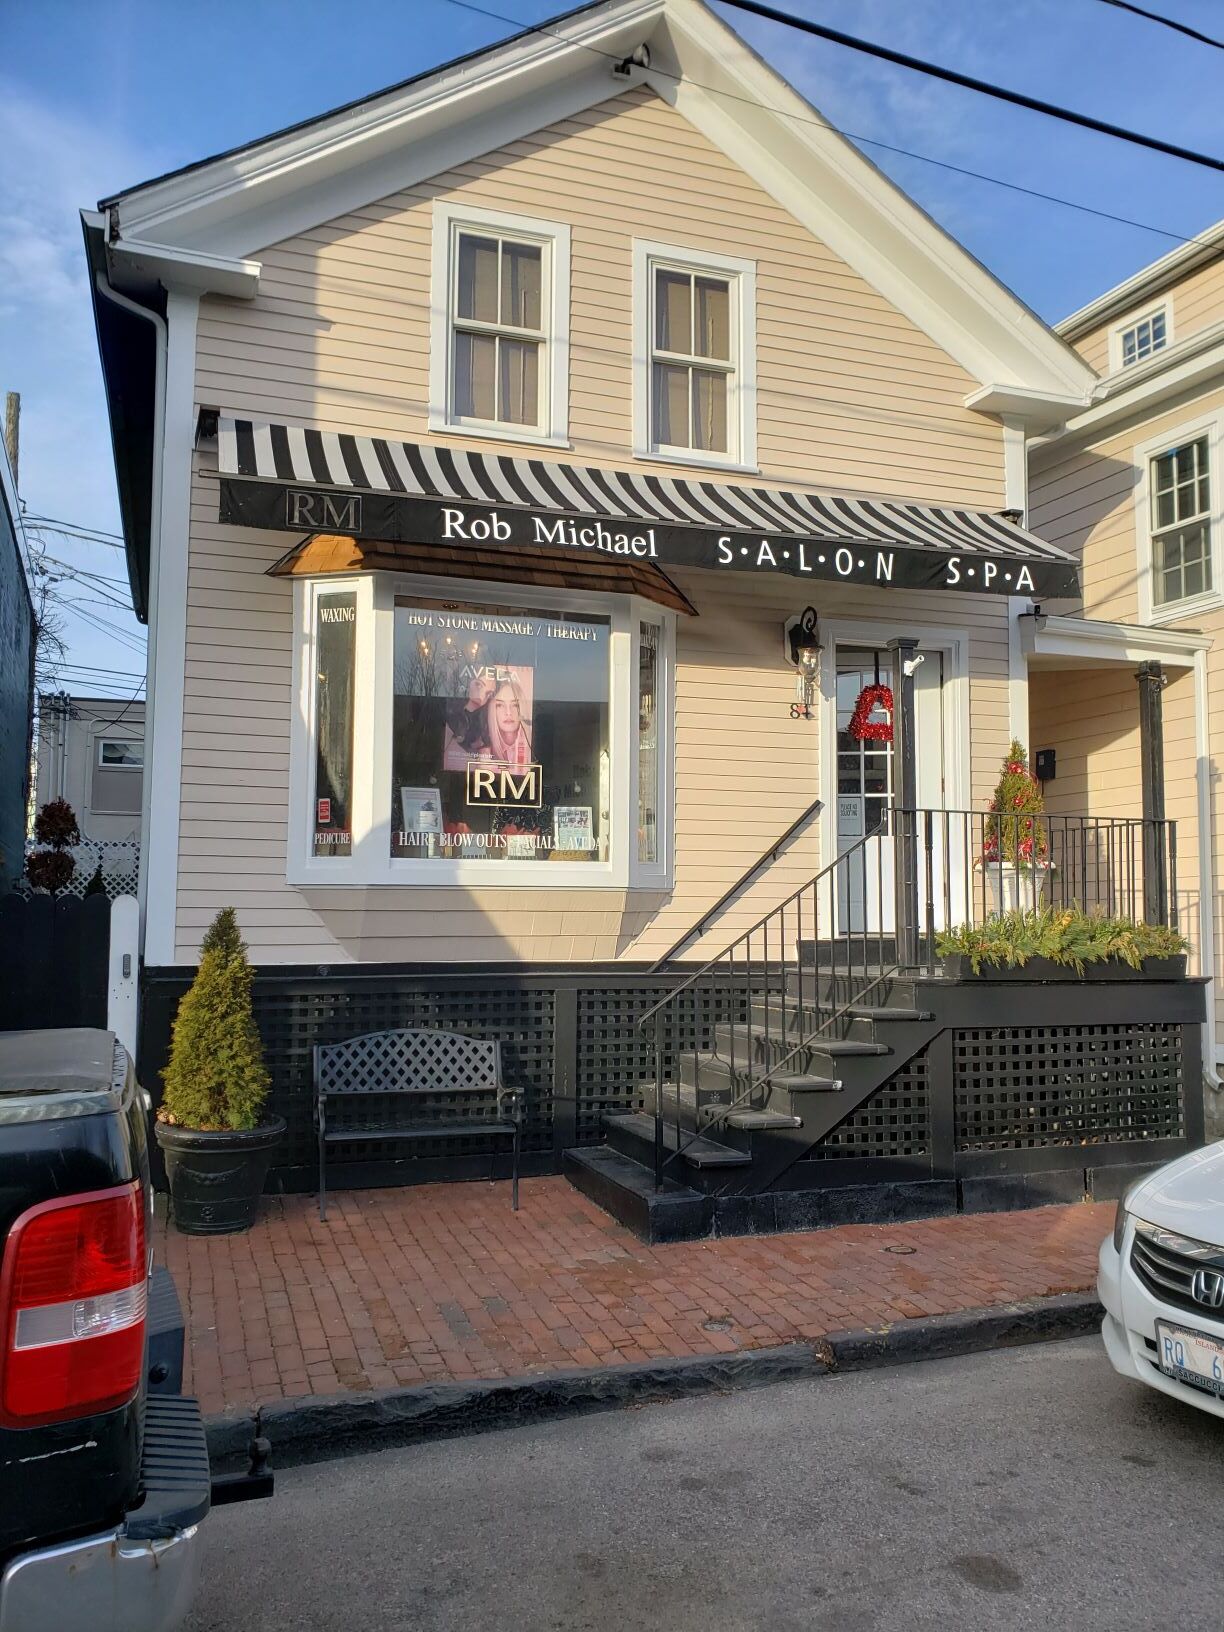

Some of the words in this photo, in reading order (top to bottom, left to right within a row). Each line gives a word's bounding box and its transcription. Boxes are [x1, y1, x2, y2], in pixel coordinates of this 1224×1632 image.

[290, 492, 358, 530] RM
[441, 508, 512, 541] Rob
[531, 517, 659, 557] Michael
[320, 607, 355, 623] WAXING
[408, 613, 433, 626] HOT
[438, 615, 478, 630] STONE
[481, 619, 533, 636] MASSAGE
[545, 624, 599, 642] THERAPY
[473, 769, 536, 800] RM
[314, 832, 351, 845] PEDICURE
[399, 831, 429, 846] HAIR
[438, 832, 475, 847] BLOW
[476, 833, 507, 848] OUTS
[1164, 1336, 1185, 1367] RQ
[1178, 1369, 1222, 1392] SACCUCCI
